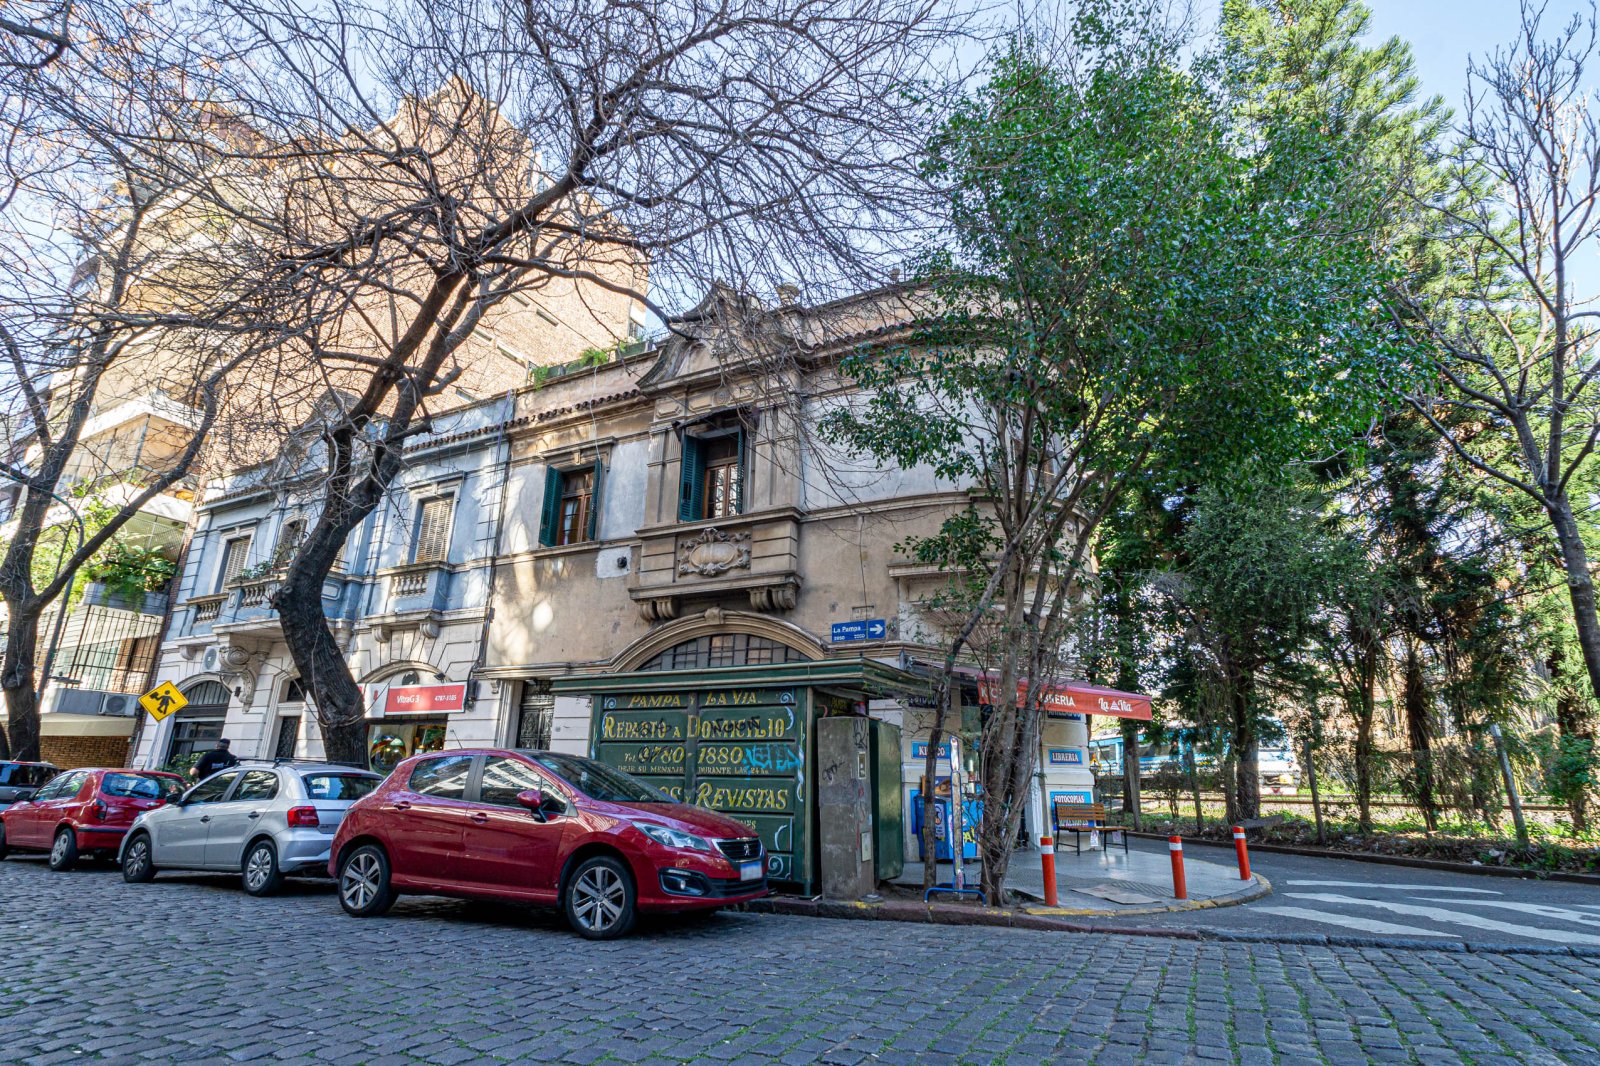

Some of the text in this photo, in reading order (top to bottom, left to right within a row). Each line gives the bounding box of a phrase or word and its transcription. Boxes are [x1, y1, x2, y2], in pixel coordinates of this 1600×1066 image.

[627, 695, 681, 709] PAMPA
[705, 692, 728, 706] LA
[603, 716, 668, 739] REPARTO
[1052, 753, 1079, 762] LIBRERIA
[695, 782, 788, 810] REVISTAS
